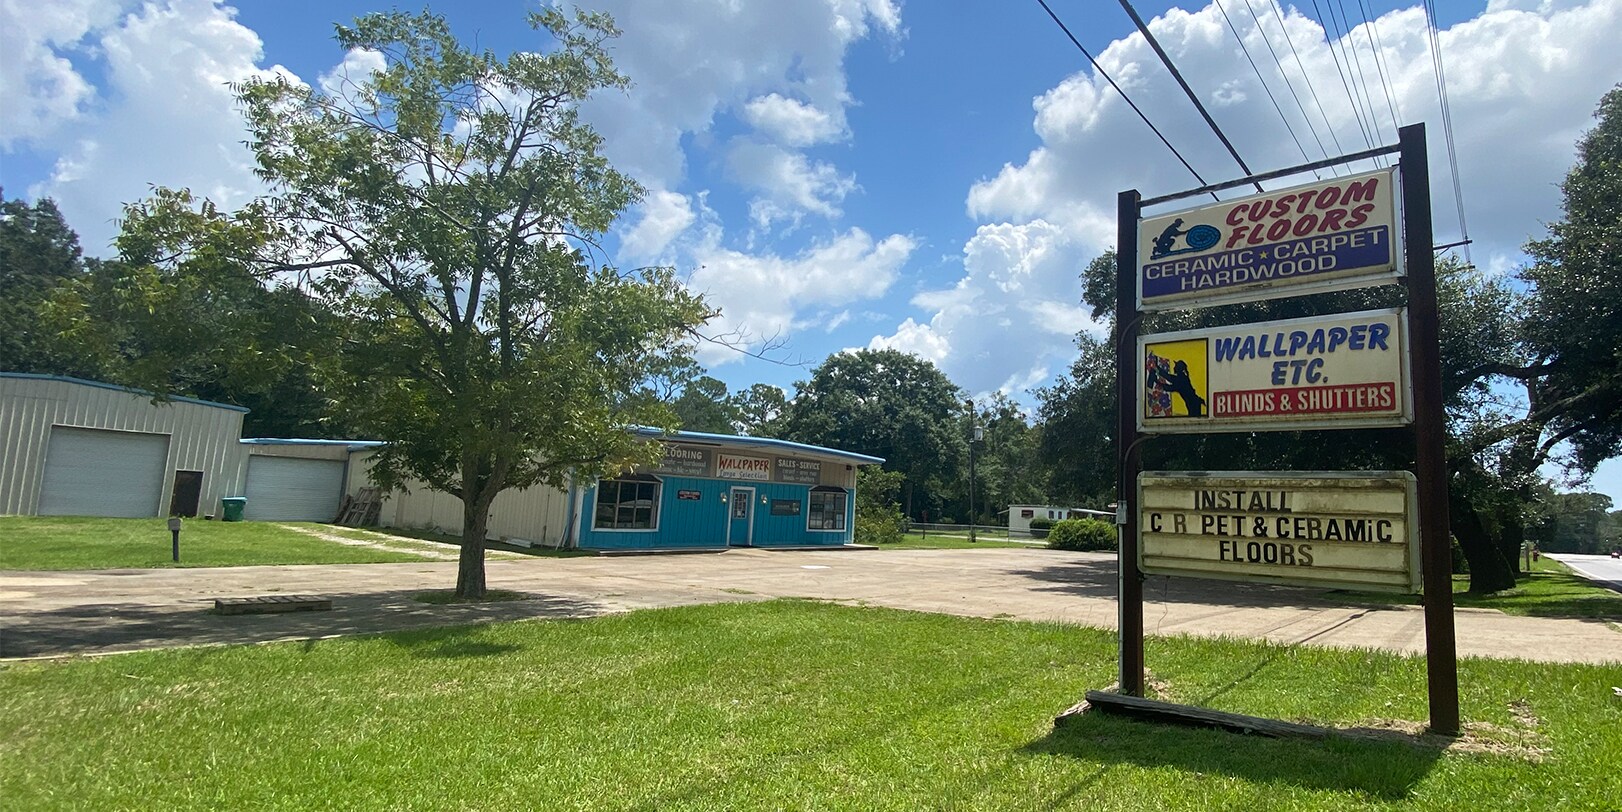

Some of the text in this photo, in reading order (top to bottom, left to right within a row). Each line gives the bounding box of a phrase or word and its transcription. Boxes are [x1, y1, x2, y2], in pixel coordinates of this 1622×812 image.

[1226, 177, 1379, 226] CUSTOM
[1225, 203, 1375, 249] FLOORS
[1145, 228, 1385, 280] CERAMIC CARPET
[1181, 254, 1337, 290] HARDWOOD
[1214, 322, 1390, 362] WALLPAPER
[1271, 357, 1329, 386] ETC.
[1216, 385, 1392, 414] BLINDS & SHUTTERS
[660, 448, 703, 460] LOORING
[719, 455, 769, 472] WALLPAPER
[778, 458, 796, 468] SALES
[799, 461, 820, 470] SERVICE
[1194, 490, 1292, 513] INSTALL
[1219, 540, 1314, 566] FLOORS
